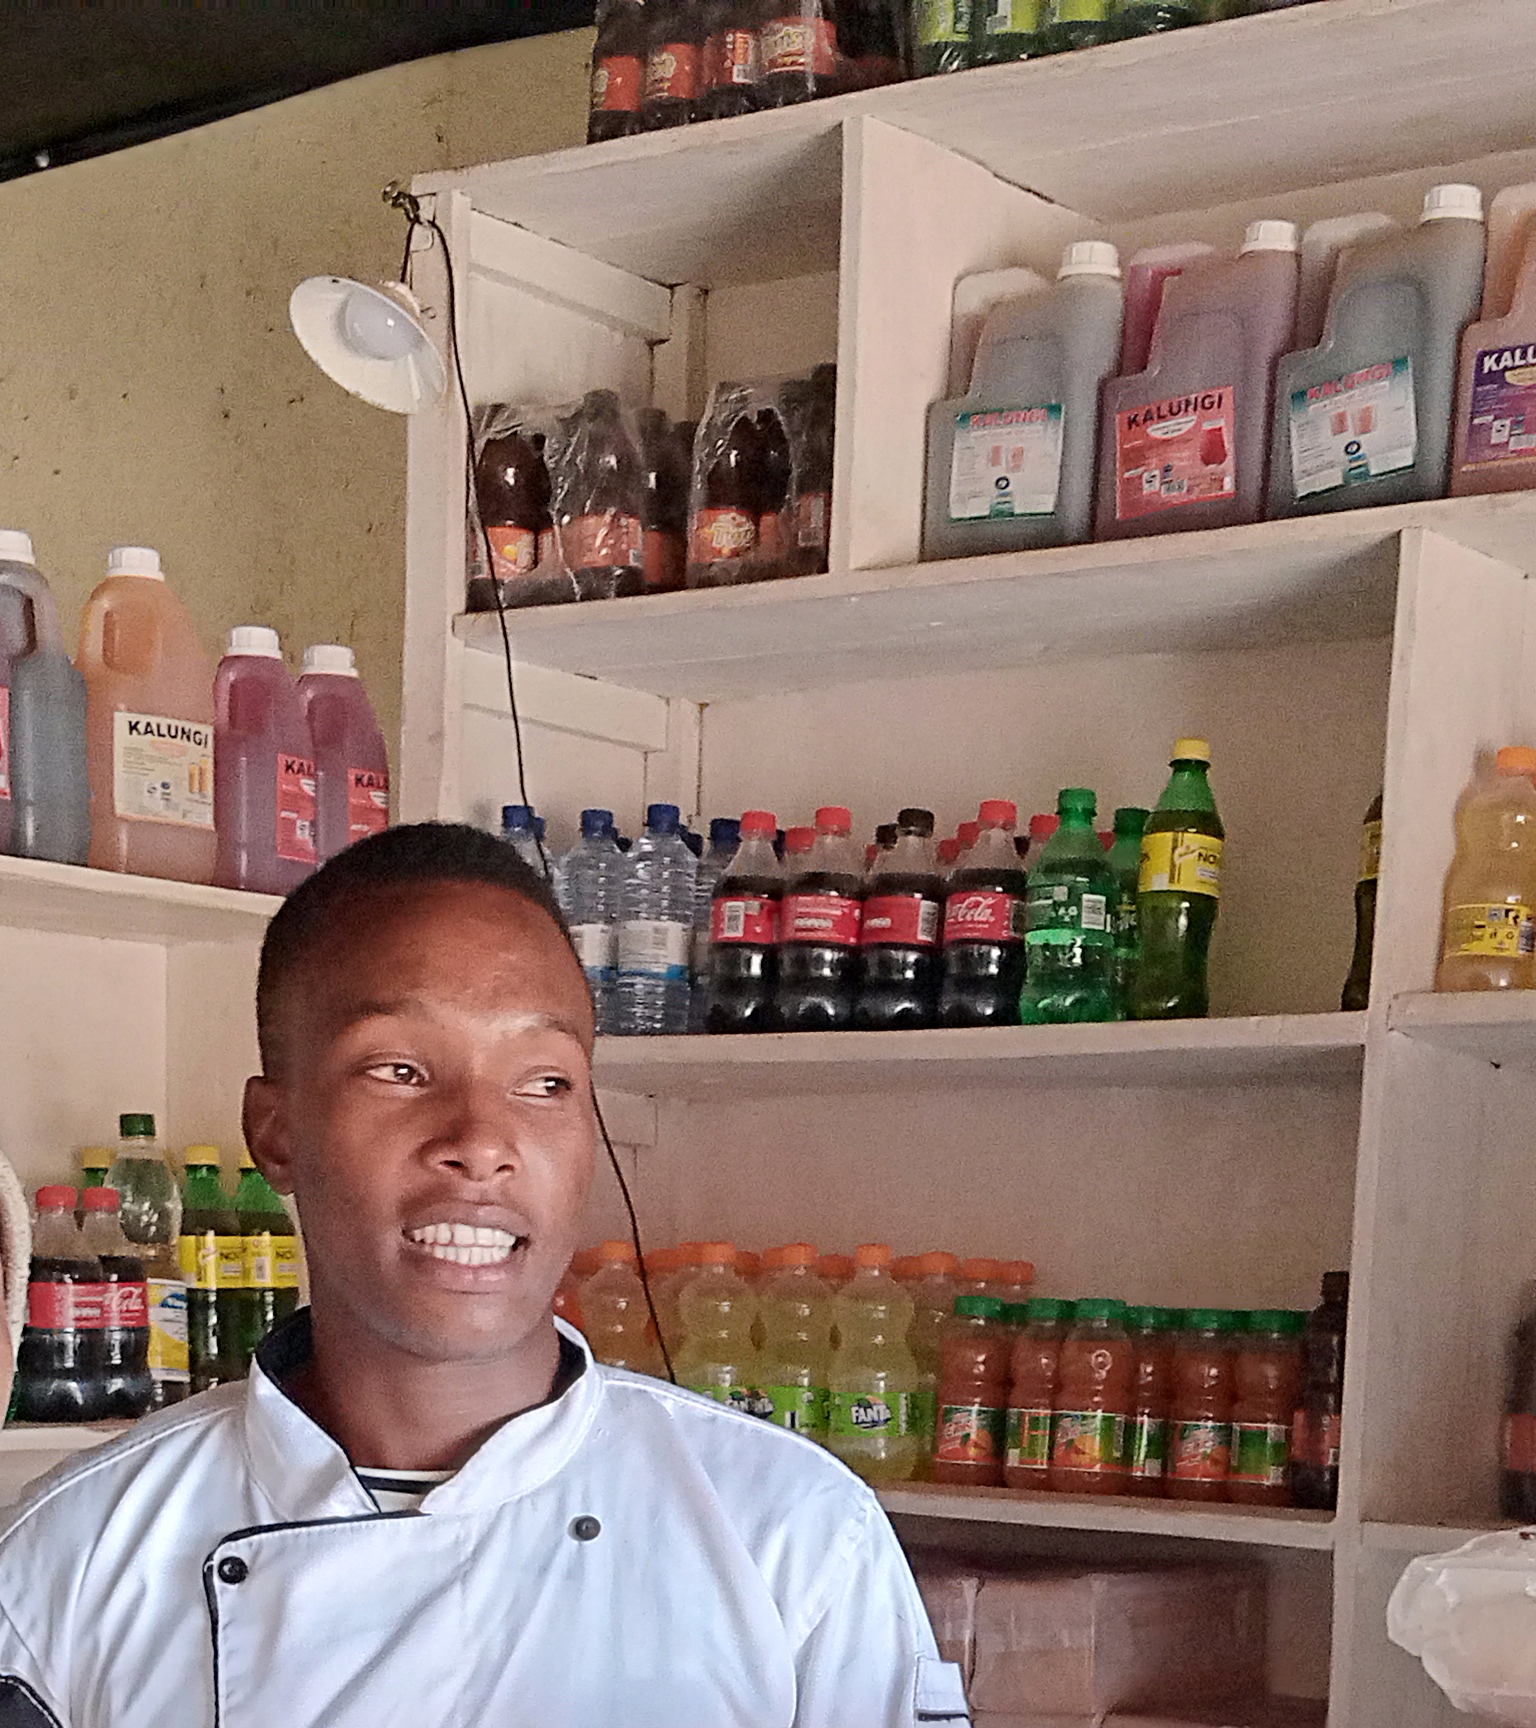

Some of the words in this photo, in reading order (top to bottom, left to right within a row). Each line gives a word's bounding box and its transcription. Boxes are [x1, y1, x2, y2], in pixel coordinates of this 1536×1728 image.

[1307, 362, 1394, 400] KALUNGI
[969, 408, 1049, 427] KALUNGI
[1126, 393, 1225, 431] KALUNGI
[127, 719, 210, 750] KALUNGI
